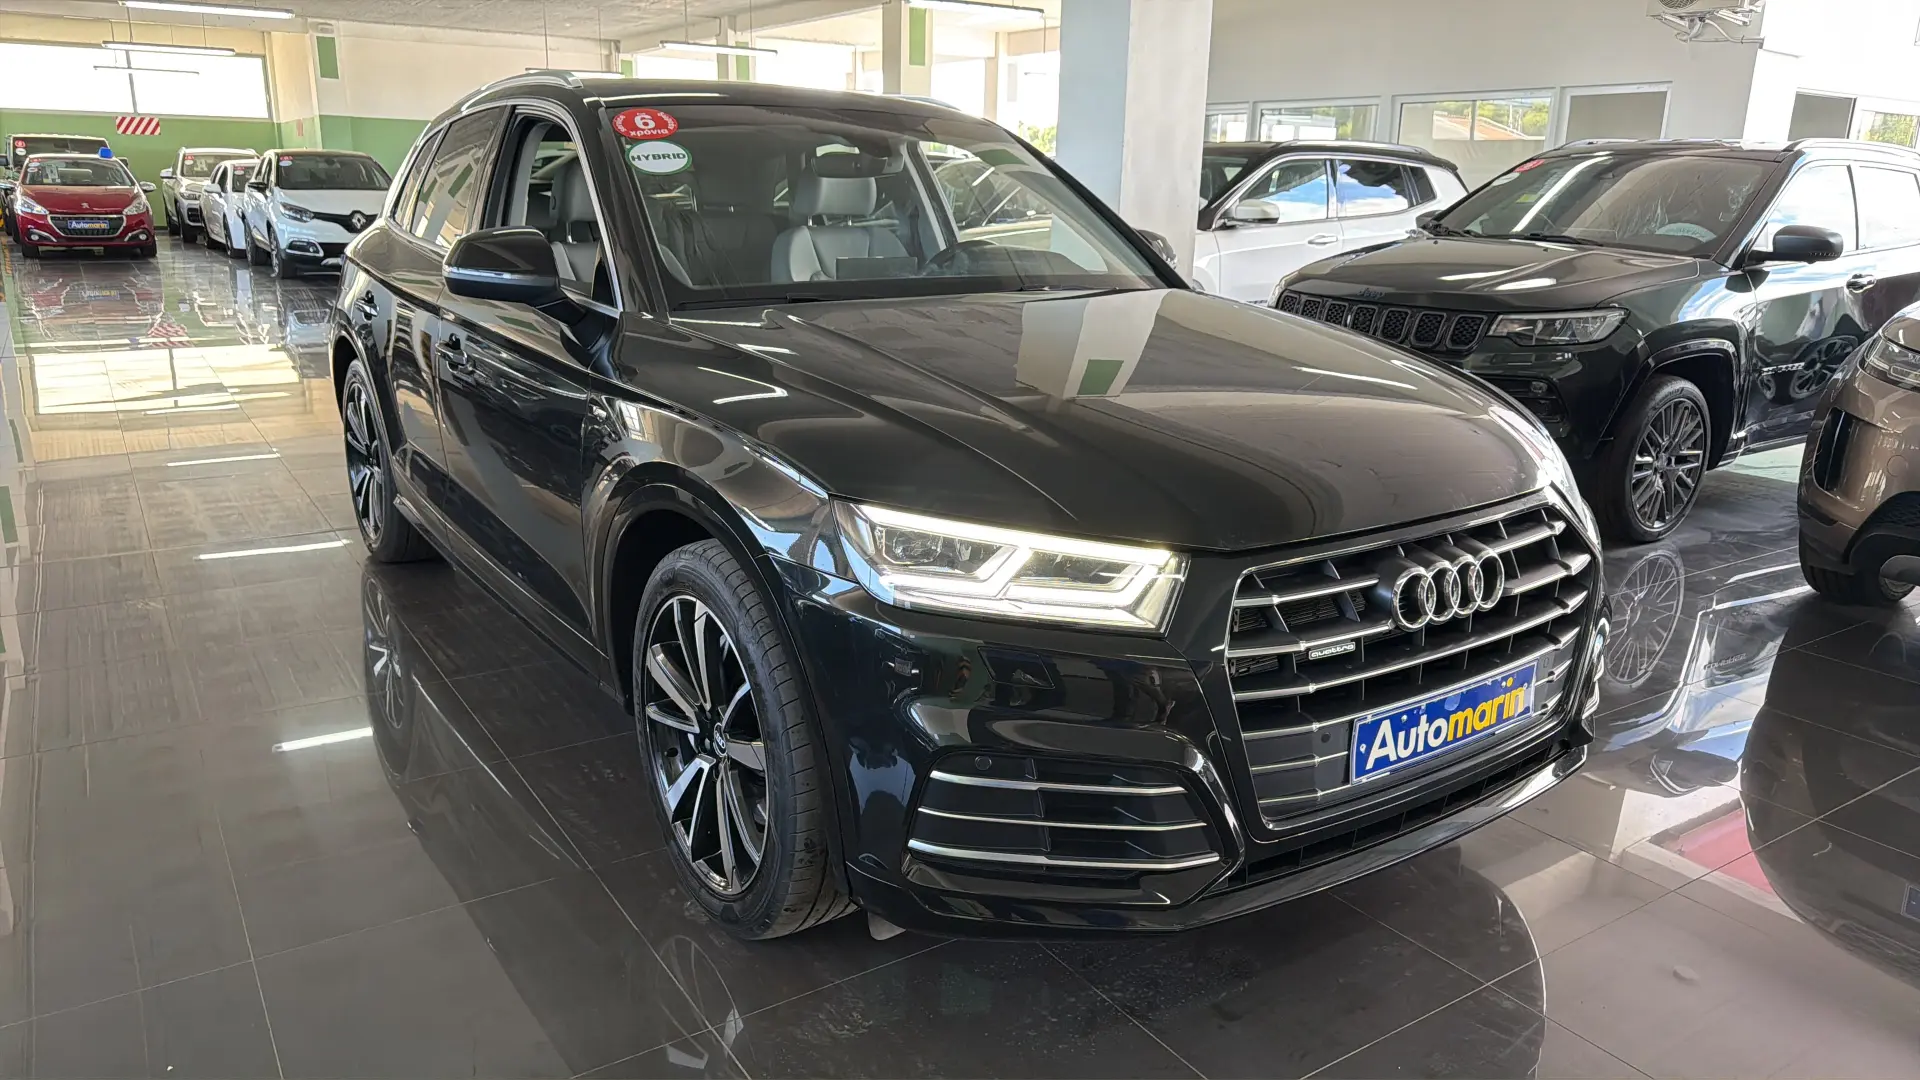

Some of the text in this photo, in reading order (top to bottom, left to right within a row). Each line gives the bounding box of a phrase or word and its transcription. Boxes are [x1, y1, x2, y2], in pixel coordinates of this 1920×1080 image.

[634, 114, 656, 130] 6
[630, 128, 669, 137] χρόνια
[630, 152, 687, 162] HYBRID
[71, 220, 108, 229] Automarin
[1311, 644, 1354, 658] quattro
[1365, 676, 1526, 770] Automarin
